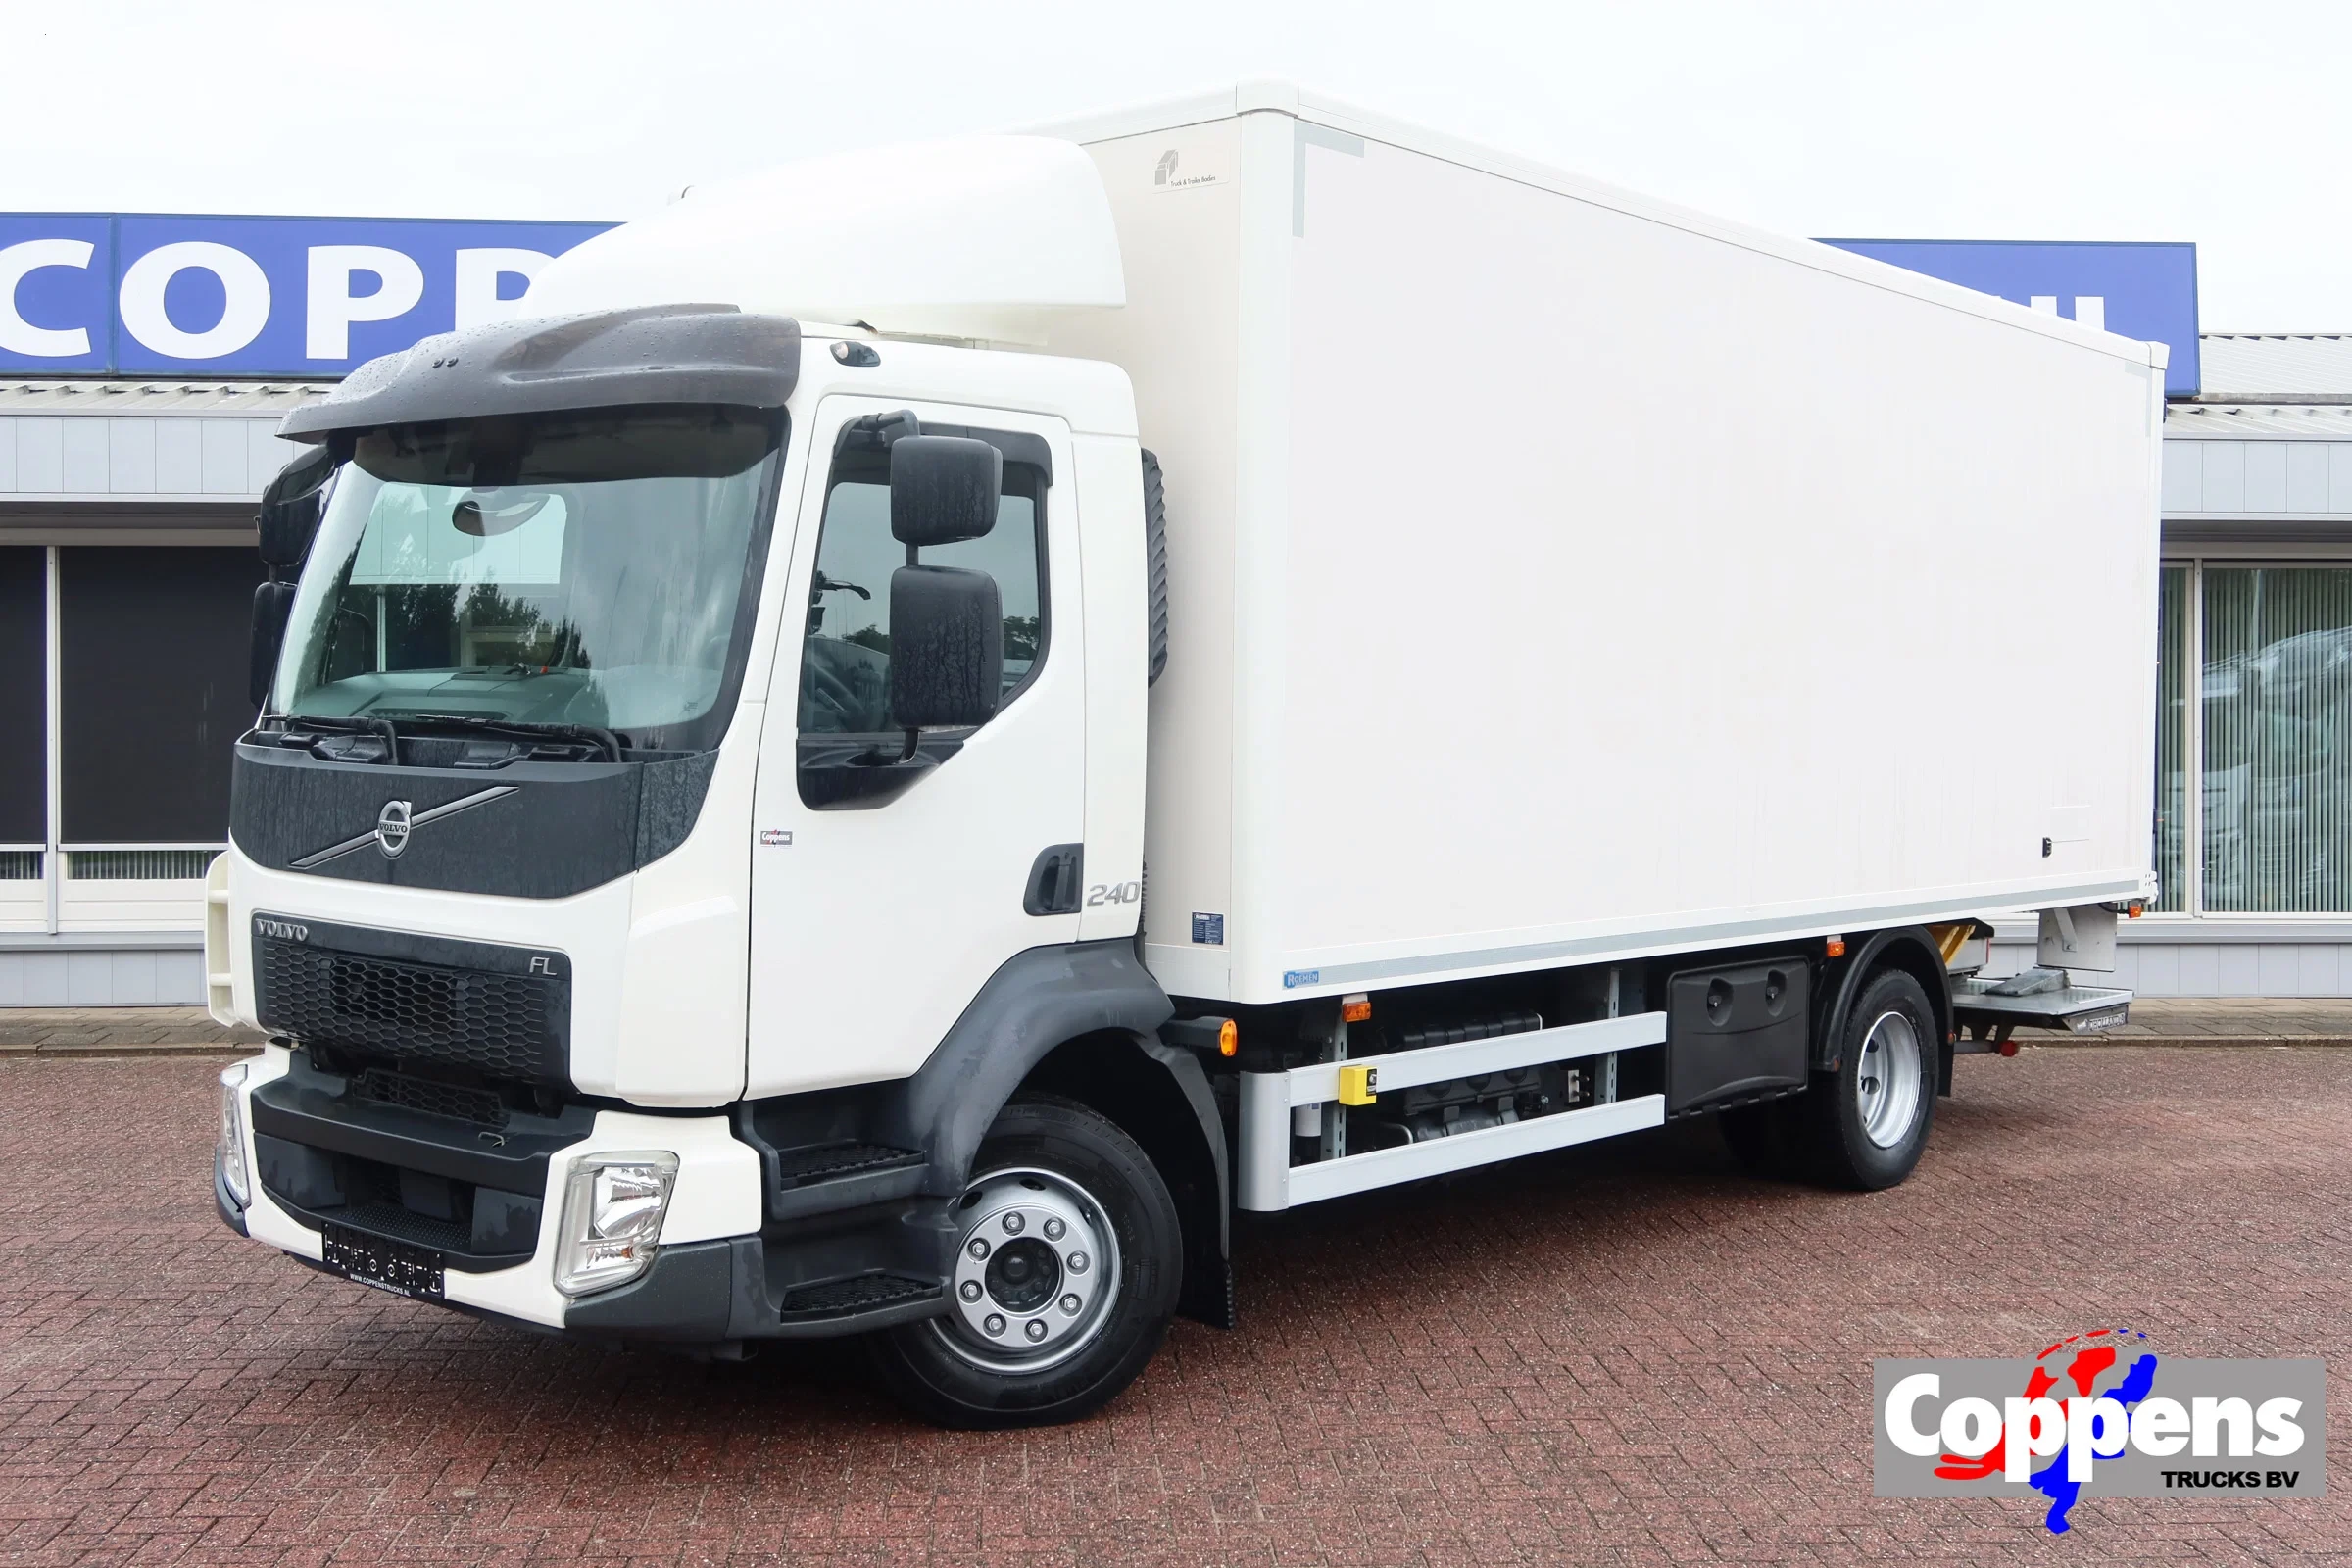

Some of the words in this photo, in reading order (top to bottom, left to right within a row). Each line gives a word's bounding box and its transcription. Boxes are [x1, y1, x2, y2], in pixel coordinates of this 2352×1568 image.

[379, 823, 408, 833] VOLVO
[761, 832, 790, 843] Coppens
[1087, 881, 1141, 906] 240
[255, 917, 308, 941] VOLVO
[529, 956, 558, 976] FL
